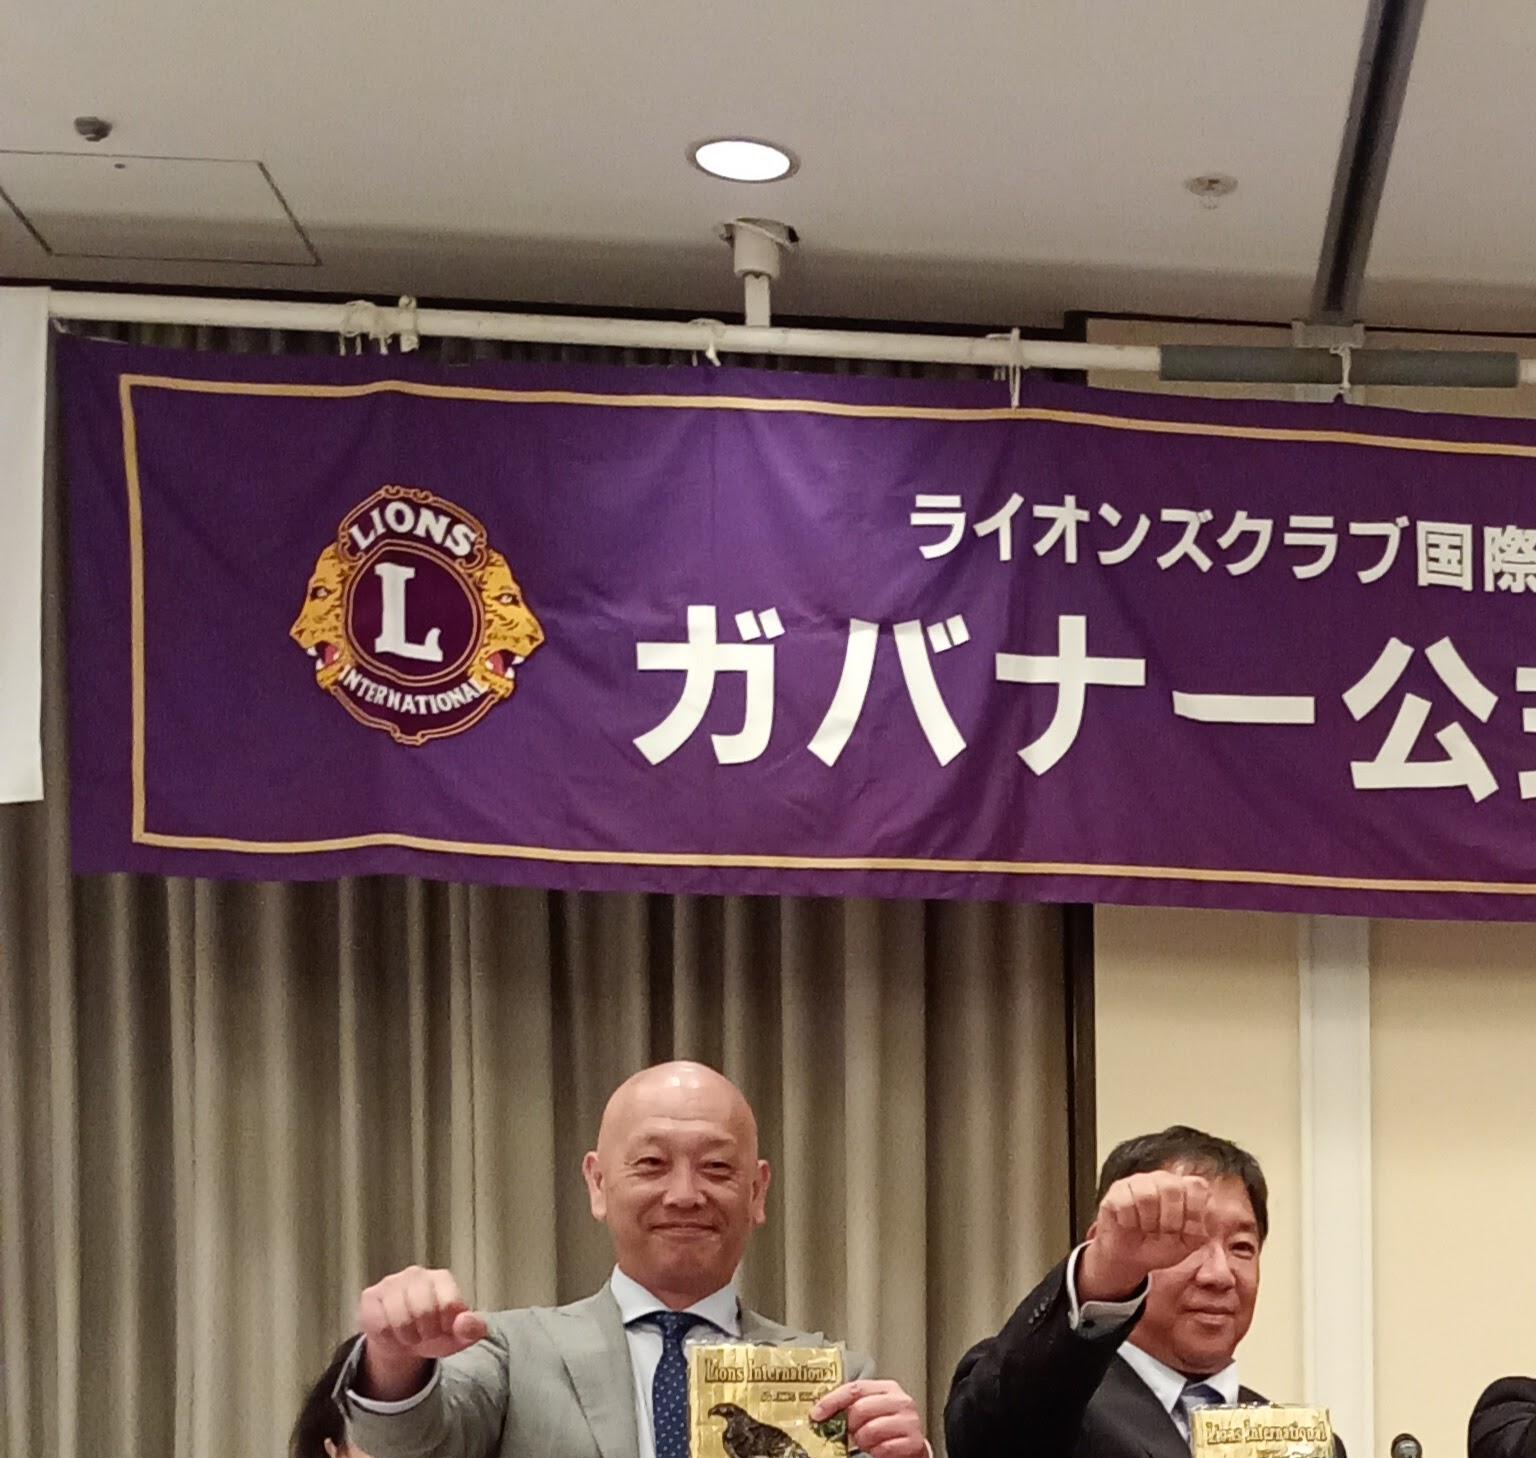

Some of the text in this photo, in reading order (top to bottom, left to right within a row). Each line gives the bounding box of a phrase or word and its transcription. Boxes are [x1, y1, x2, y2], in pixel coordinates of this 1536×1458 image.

[349, 501, 477, 557] LIONS
[374, 562, 443, 662] L
[340, 664, 490, 715] INTERNATIONAL
